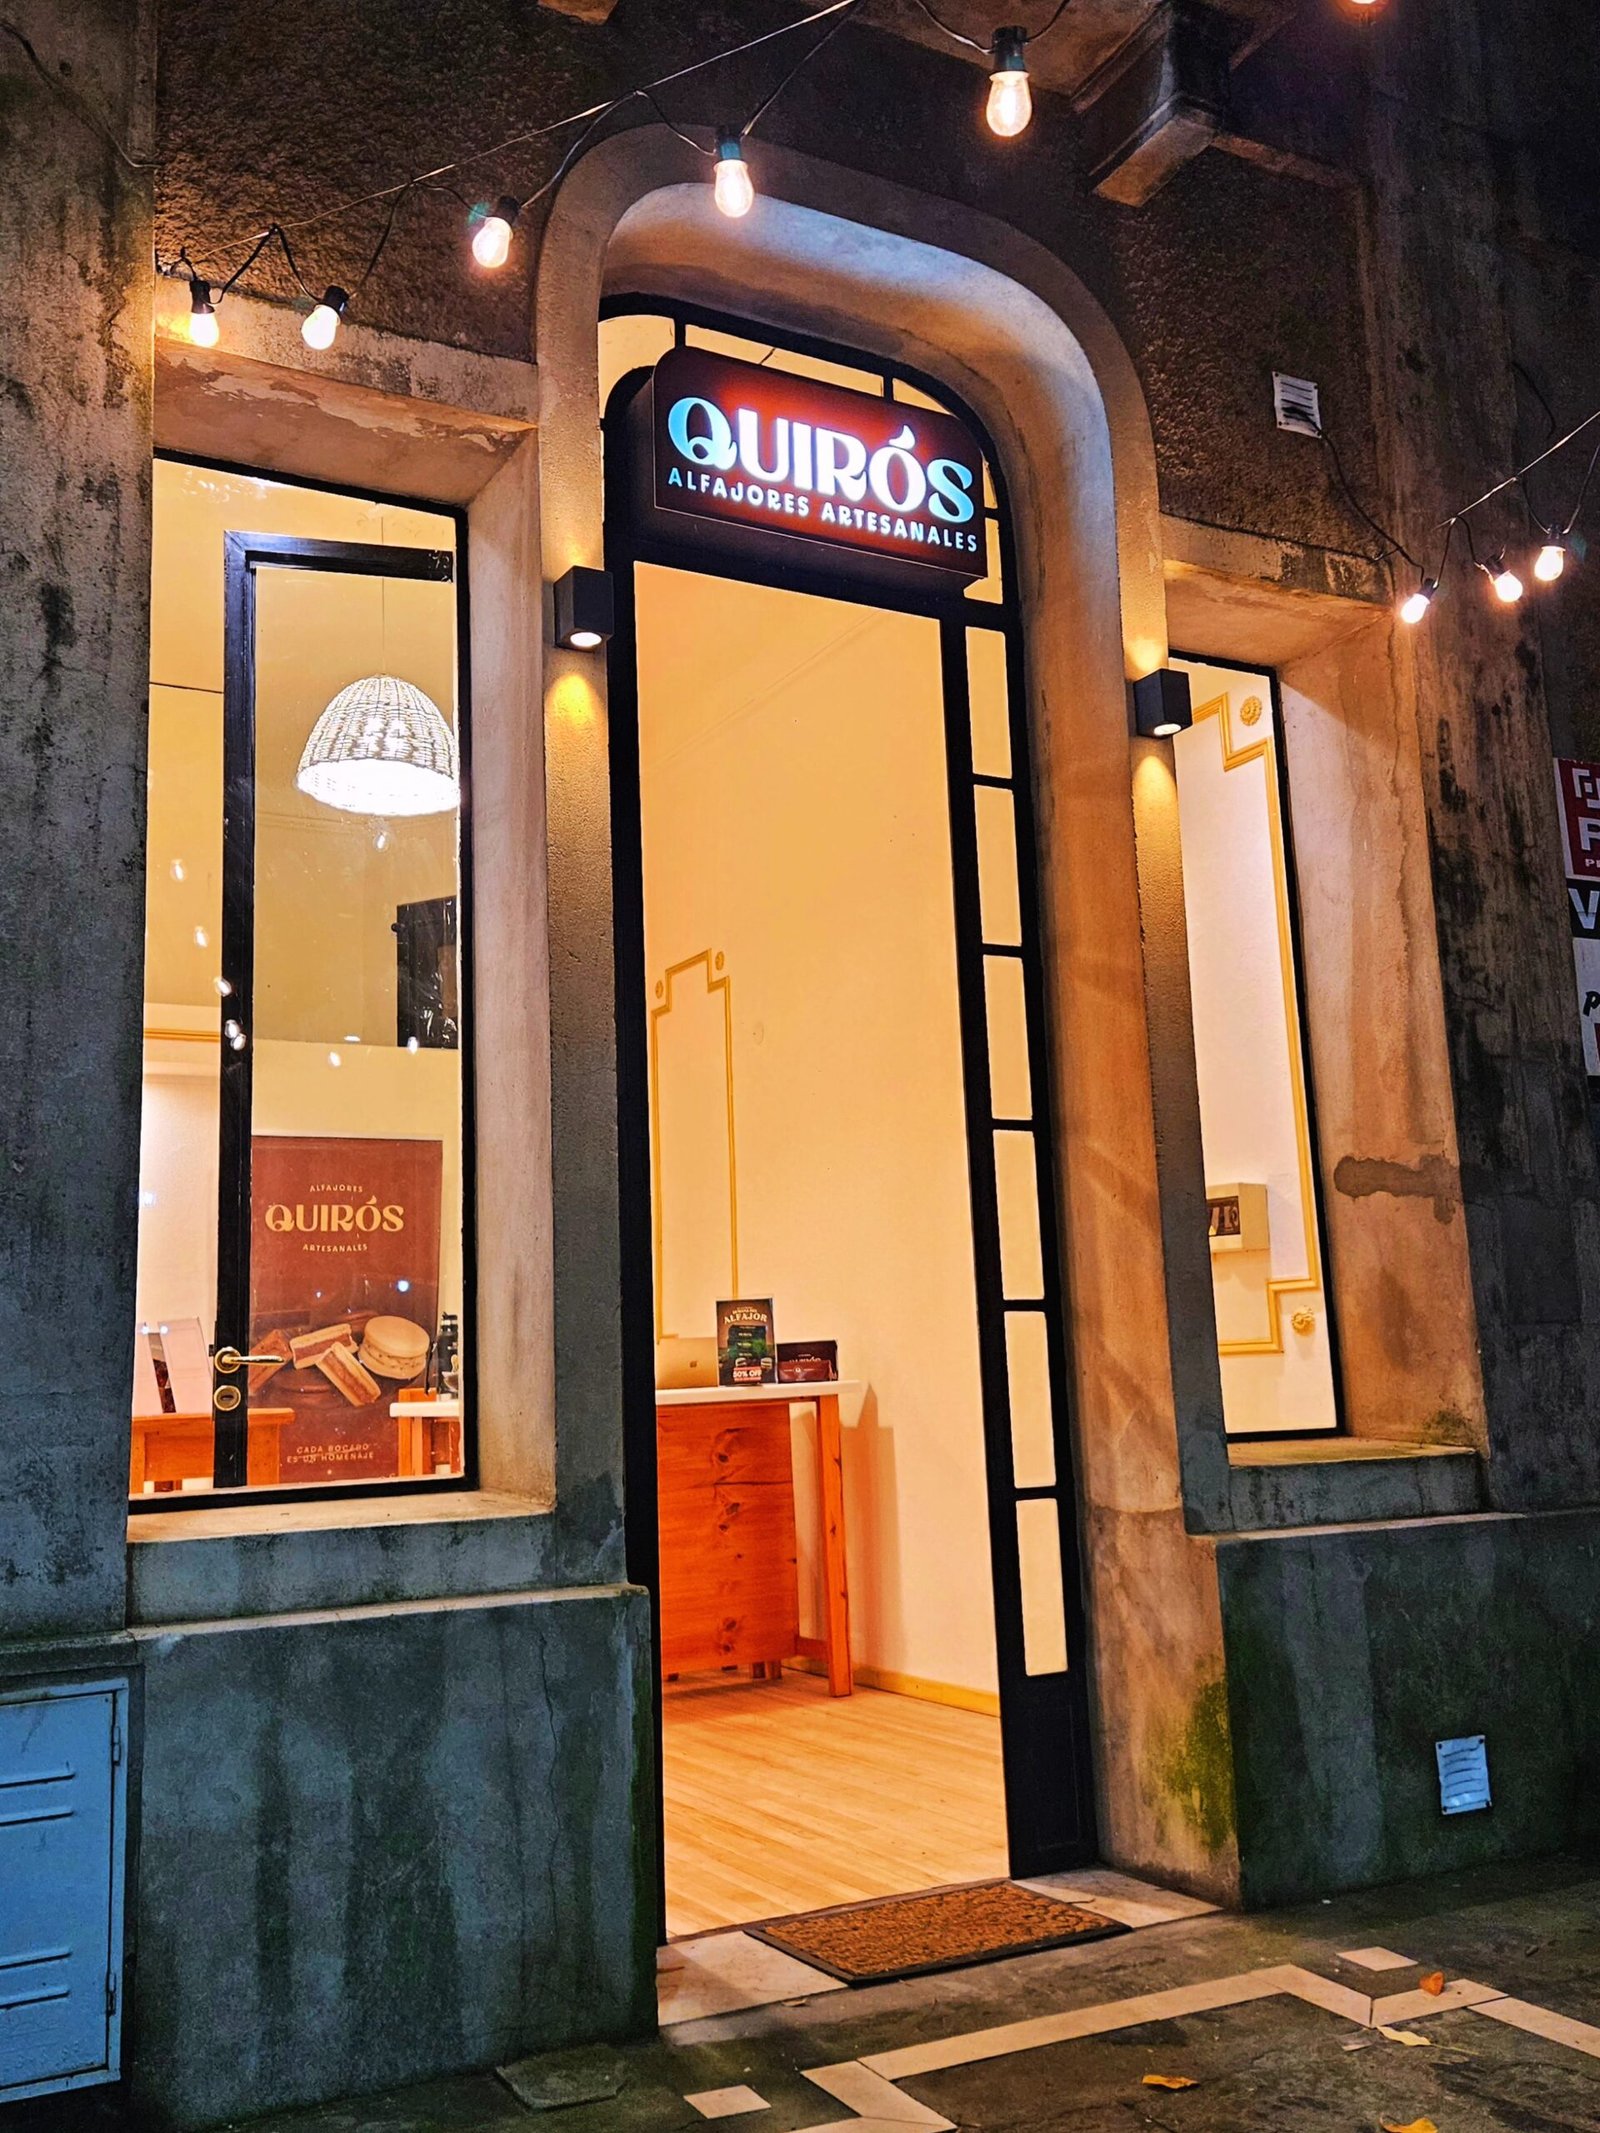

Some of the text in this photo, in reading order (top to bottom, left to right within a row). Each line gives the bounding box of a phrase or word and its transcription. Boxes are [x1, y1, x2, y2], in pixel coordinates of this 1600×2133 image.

[667, 396, 975, 523] QUIRÓS
[668, 467, 978, 553] ALFAJORES ARTESANALES
[309, 1183, 363, 1193] ALFAJORES
[265, 1195, 404, 1233] QUIRÓS
[302, 1243, 368, 1253] ARTESANALES
[724, 1312, 768, 1325] ALFAJOR
[296, 1445, 323, 1454] CADA
[286, 1455, 298, 1463] ES
[321, 1452, 374, 1461] HOMENAJE
